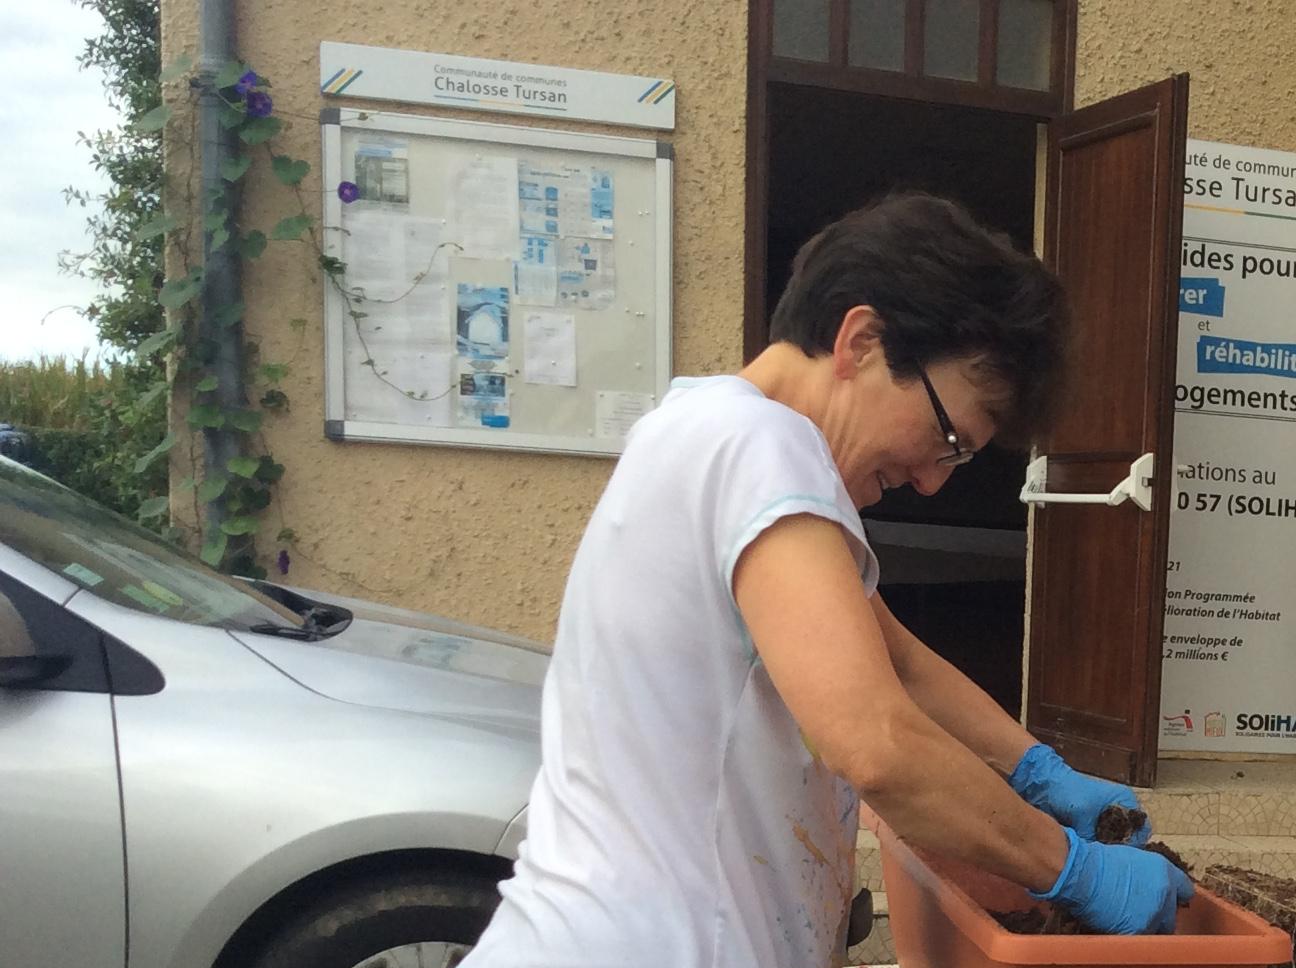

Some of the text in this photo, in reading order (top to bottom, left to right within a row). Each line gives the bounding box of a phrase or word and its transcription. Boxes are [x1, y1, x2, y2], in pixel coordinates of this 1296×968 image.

[434, 64, 567, 87] Communauté de communes
[434, 77, 567, 103] Chalosse Tursan
[1213, 155, 1231, 170] de
[1182, 242, 1234, 271] ides
[1197, 320, 1211, 331] et
[1252, 469, 1276, 485] au
[1195, 493, 1222, 512] 57
[1184, 589, 1256, 603] Programmée
[1217, 608, 1231, 618] de
[1170, 634, 1228, 648] enveloppe
[1229, 636, 1244, 647] de
[1175, 649, 1219, 661] millions
[1221, 651, 1229, 661] €
